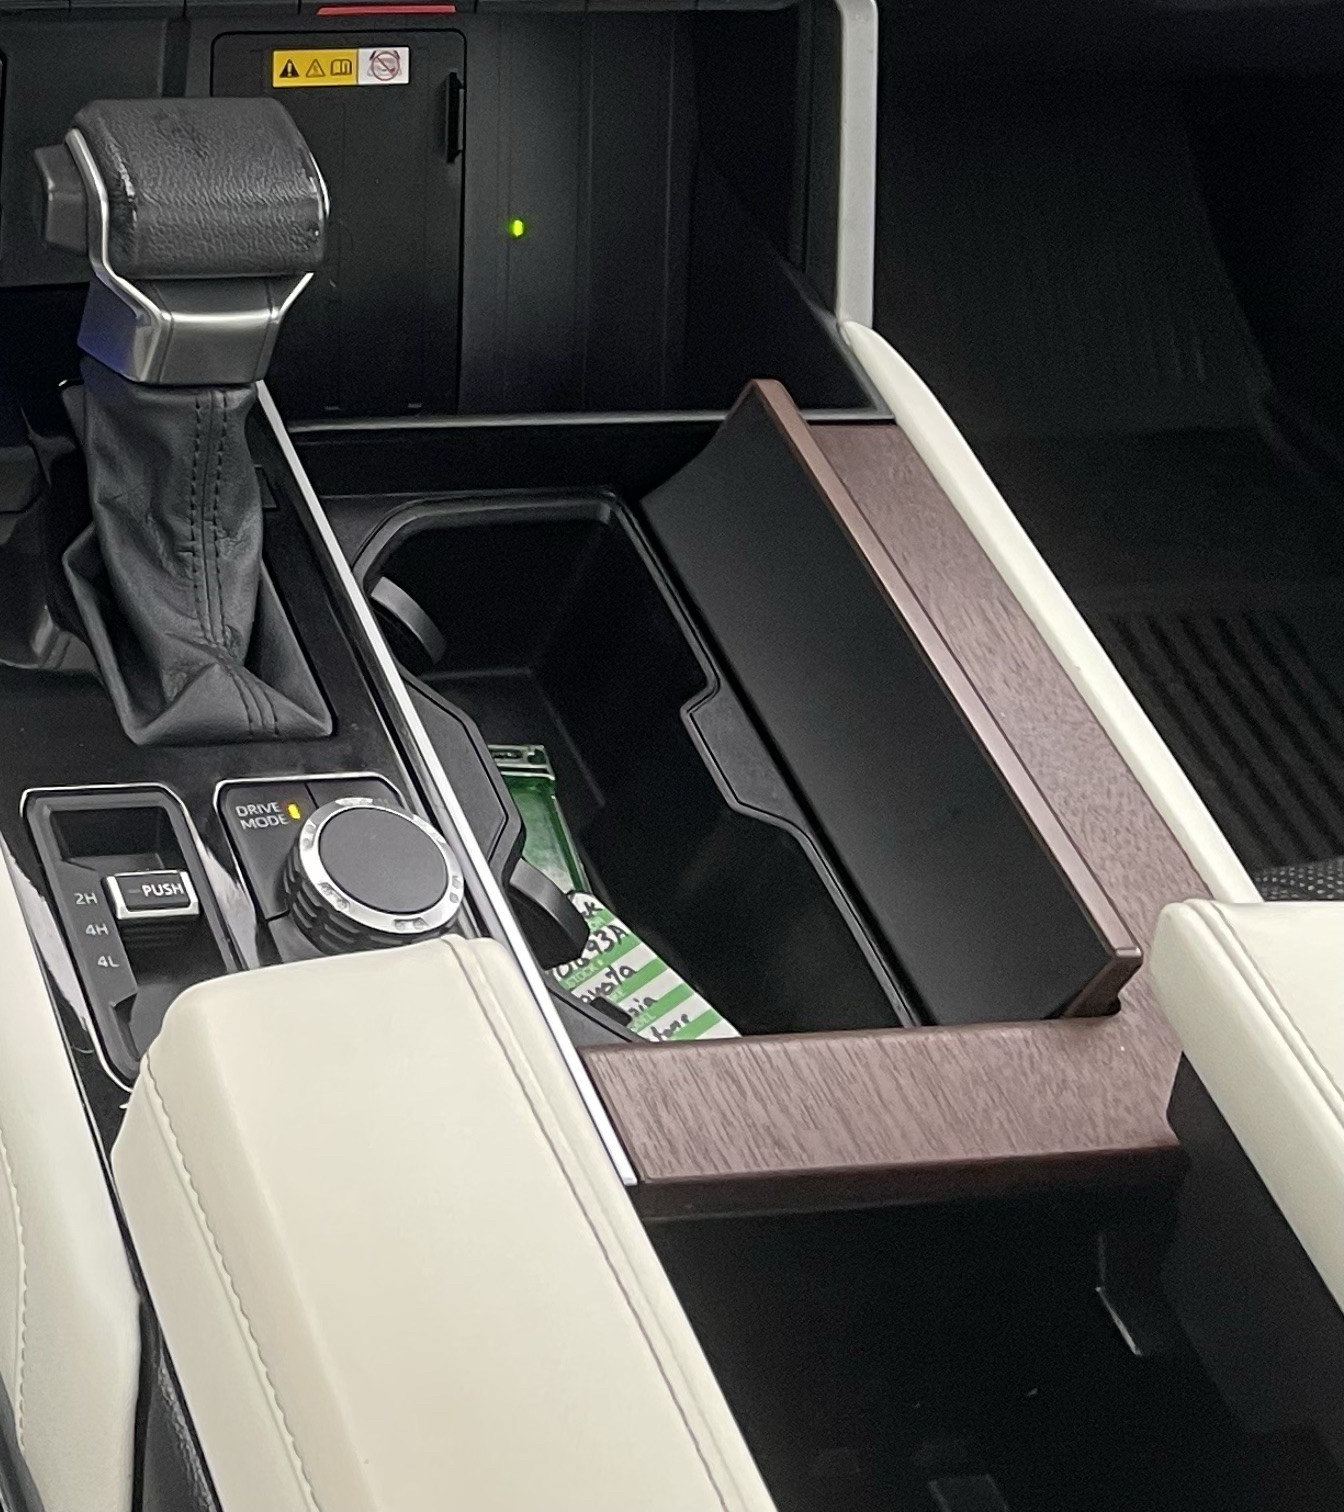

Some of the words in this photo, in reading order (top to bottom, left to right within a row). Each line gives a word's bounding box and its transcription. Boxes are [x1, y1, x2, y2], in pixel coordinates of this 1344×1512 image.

[235, 802, 281, 817] DRIVE
[240, 814, 289, 830] MODE
[142, 883, 185, 897] PUSH
[75, 893, 99, 905] 2H
[85, 924, 109, 937] 4H
[97, 956, 120, 968] 4L
